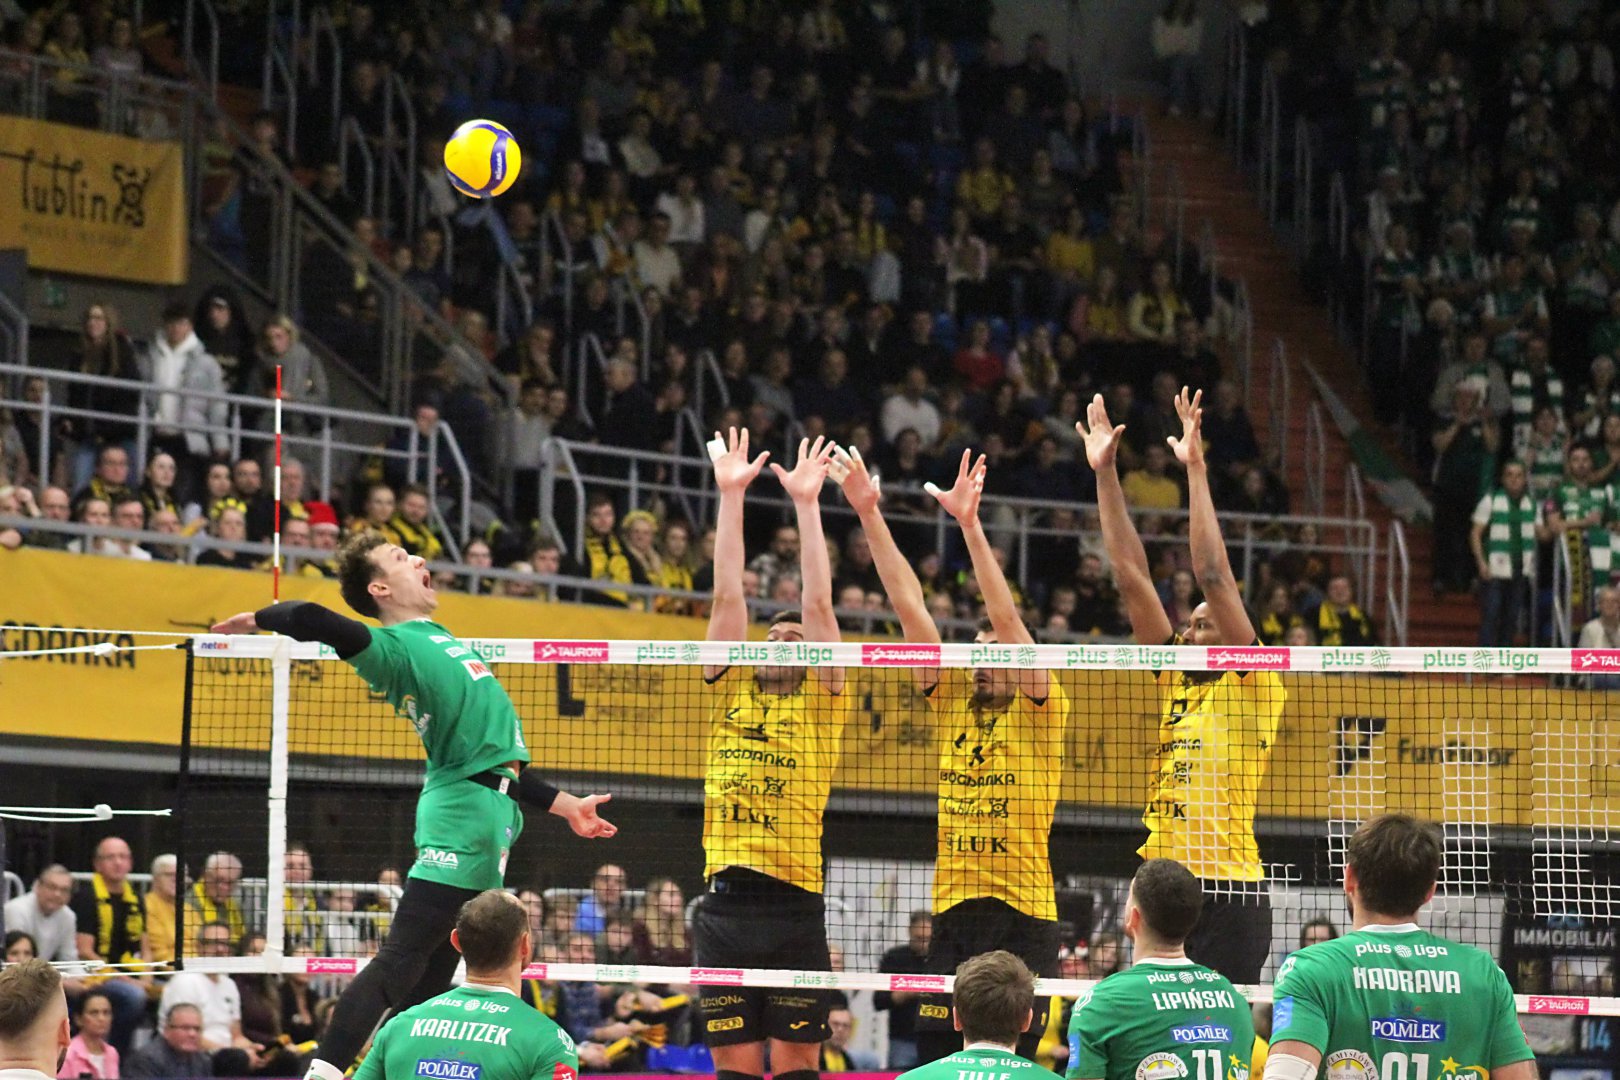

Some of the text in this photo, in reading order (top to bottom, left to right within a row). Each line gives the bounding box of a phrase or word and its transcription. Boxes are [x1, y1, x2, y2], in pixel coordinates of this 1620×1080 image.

[201, 642, 229, 650] netex
[557, 647, 603, 658] TAURON
[637, 643, 676, 662] plus
[728, 644, 832, 664] plus liga
[971, 646, 1012, 666] plus
[1067, 647, 1176, 668] plus liga
[1234, 653, 1284, 664] TAURON
[1322, 649, 1365, 669] plus
[1423, 650, 1539, 671] plus liga
[957, 834, 1009, 853] LUK
[1355, 941, 1448, 958] plus liga
[793, 973, 822, 987] plus
[1146, 970, 1220, 984] plus liga
[1353, 966, 1461, 994] HADRAVA
[431, 997, 510, 1013] plus liga
[1152, 988, 1235, 1011] LIPIŃSKI
[1549, 1001, 1584, 1011] TAURON
[410, 1018, 513, 1047] KARLITZEK
[1173, 1027, 1229, 1042] POLMLEK
[1372, 1020, 1442, 1040] POLMLEK
[417, 1061, 480, 1080] POLMLEK
[940, 1056, 1033, 1069] plus liga
